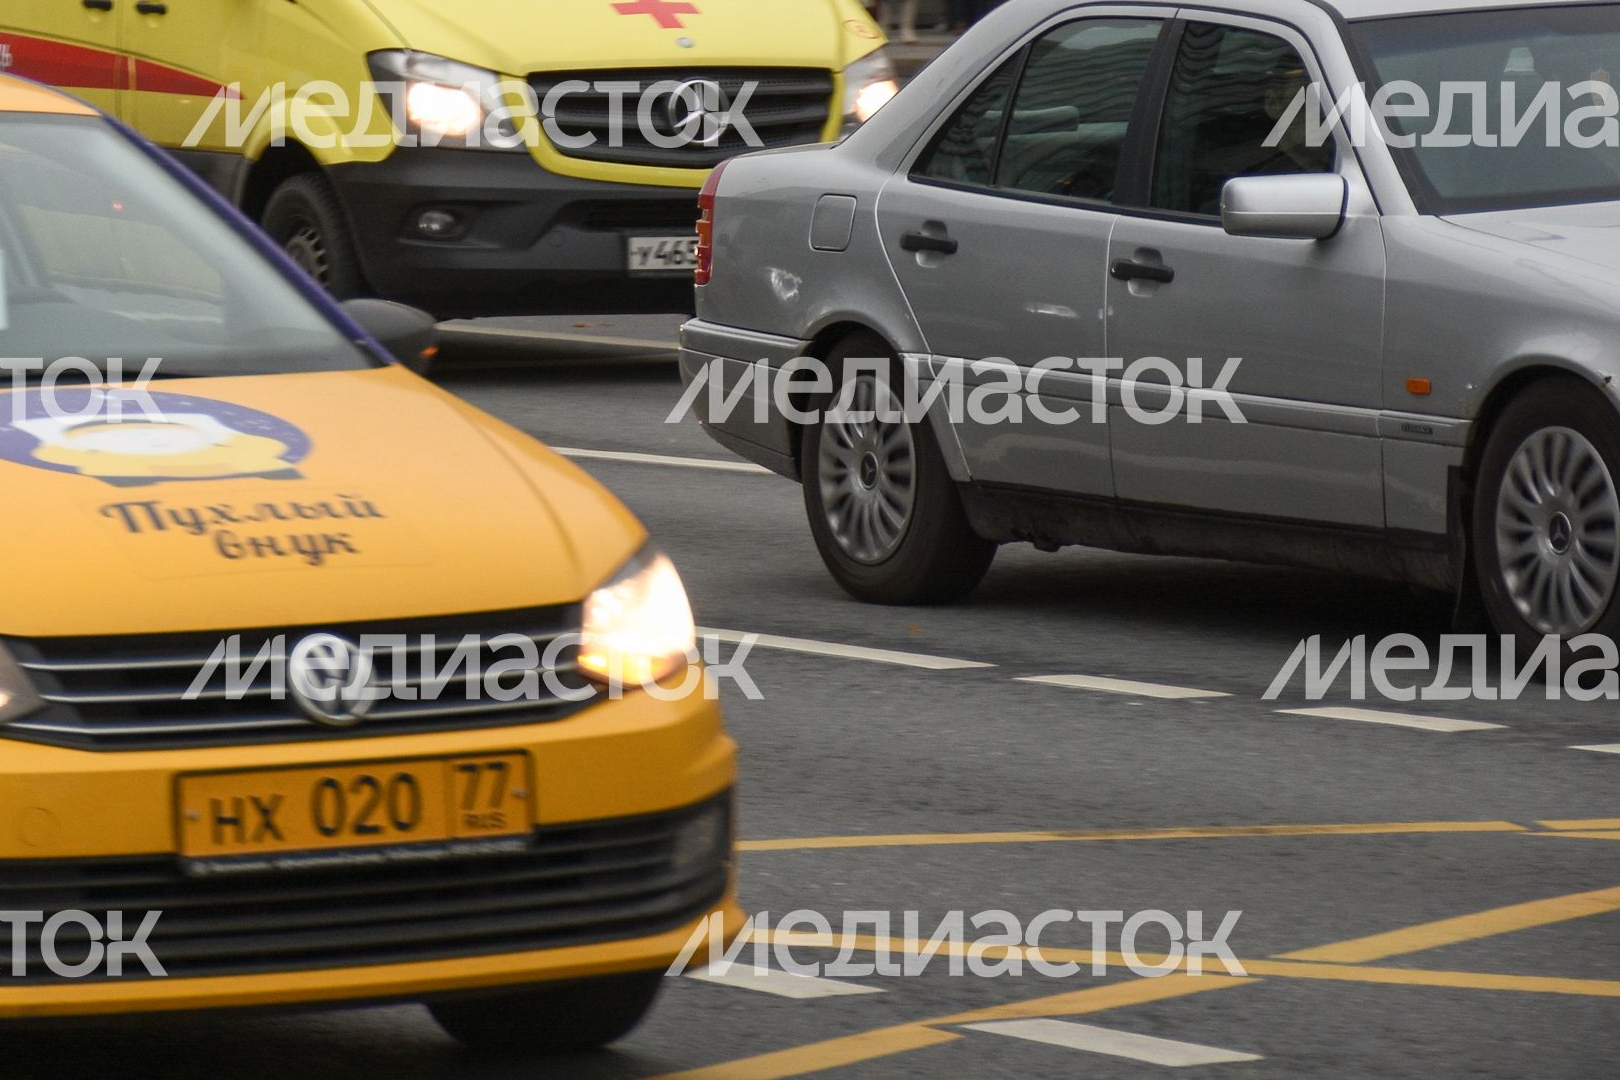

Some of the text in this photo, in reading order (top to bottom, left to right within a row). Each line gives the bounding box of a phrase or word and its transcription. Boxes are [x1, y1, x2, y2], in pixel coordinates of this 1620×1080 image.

[99, 493, 386, 535] Пухлый
[213, 530, 360, 566] внук
[208, 761, 509, 845] НХ 020 77
